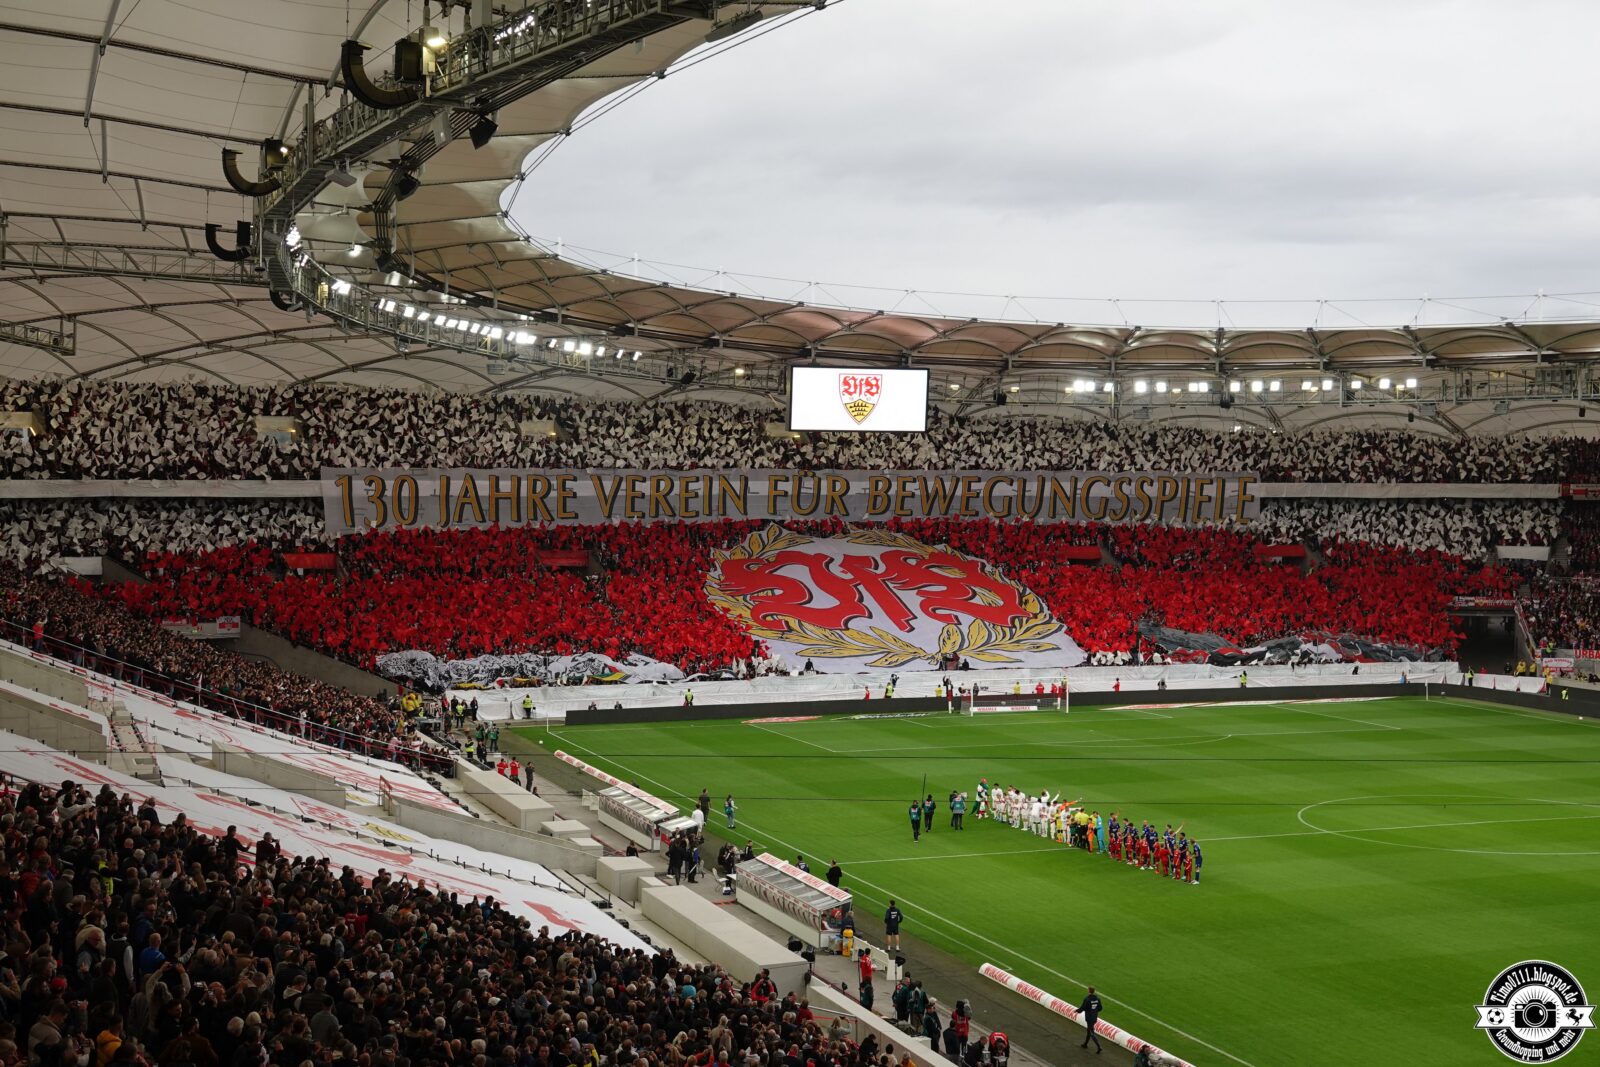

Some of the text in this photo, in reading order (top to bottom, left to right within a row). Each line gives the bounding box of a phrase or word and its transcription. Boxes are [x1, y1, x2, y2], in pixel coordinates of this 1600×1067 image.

[334, 470, 1258, 529] 130 JAHRE VEREIN FÜR BEWEGUNGSSPIELE
